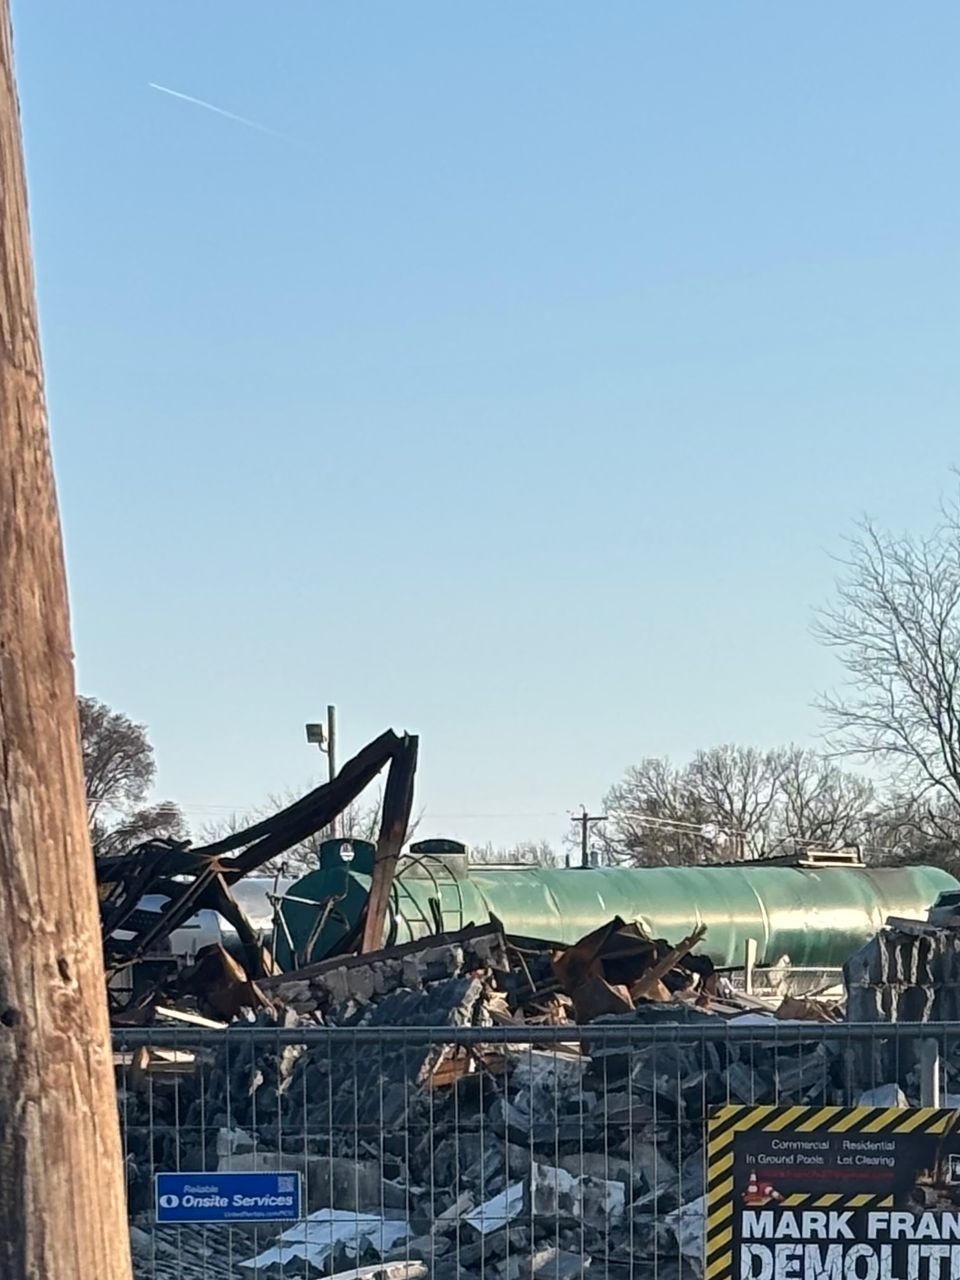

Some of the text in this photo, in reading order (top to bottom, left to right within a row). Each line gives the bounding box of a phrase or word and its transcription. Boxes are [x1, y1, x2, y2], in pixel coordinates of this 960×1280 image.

[771, 1139, 896, 1151] Commercial Residential
[745, 1154, 895, 1167] In Ground Pools Lot Clearing
[182, 1193, 293, 1208] Onsite Services
[741, 1211, 855, 1239] MARK
